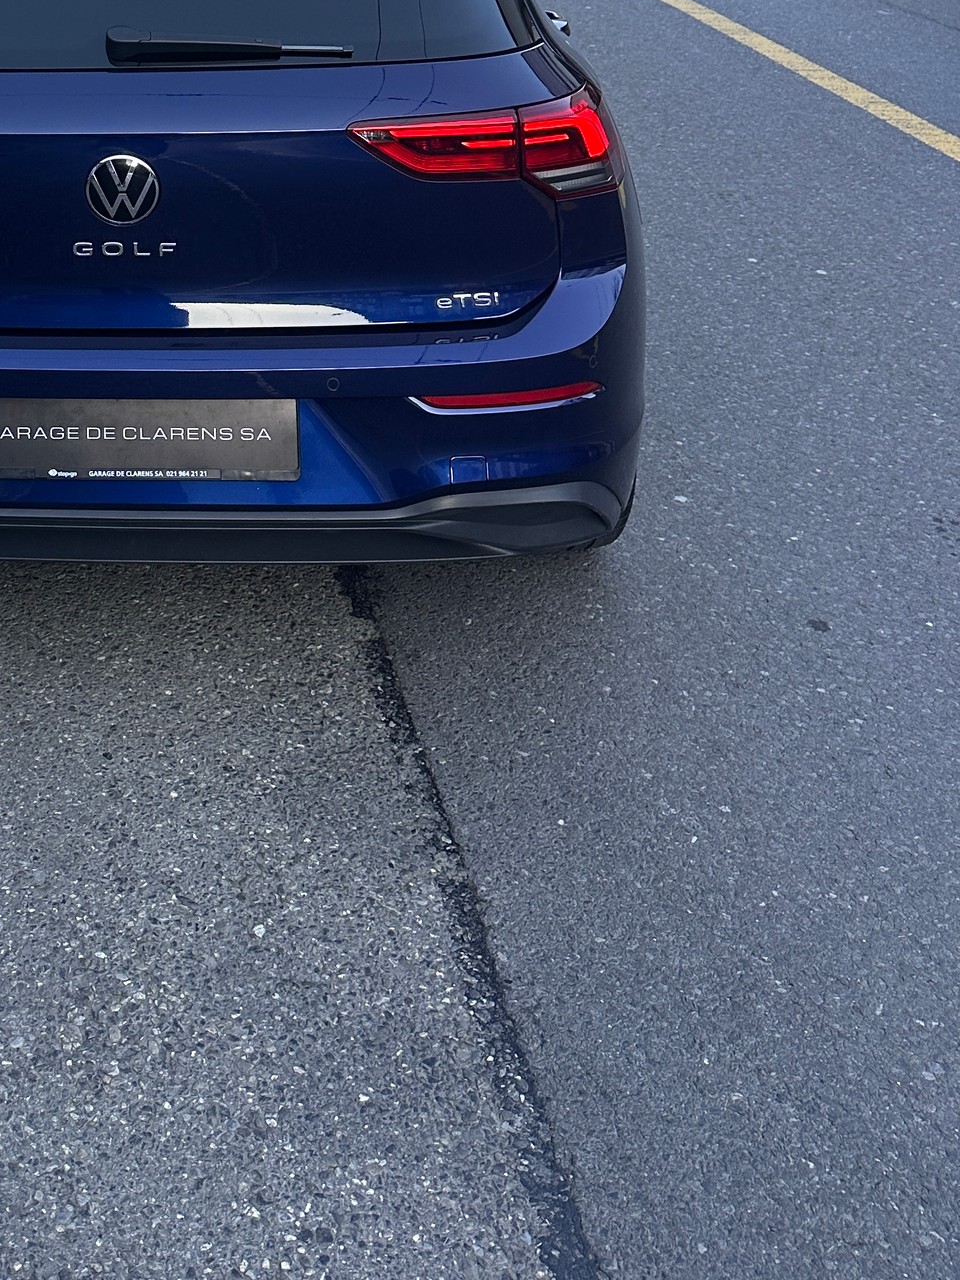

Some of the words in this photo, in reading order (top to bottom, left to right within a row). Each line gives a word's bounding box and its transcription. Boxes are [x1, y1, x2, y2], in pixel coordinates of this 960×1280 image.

[73, 241, 177, 257] GOLF
[436, 291, 500, 309] eTSI
[86, 426, 116, 440] DE
[122, 426, 233, 441] CLARENS
[240, 426, 272, 441] SA
